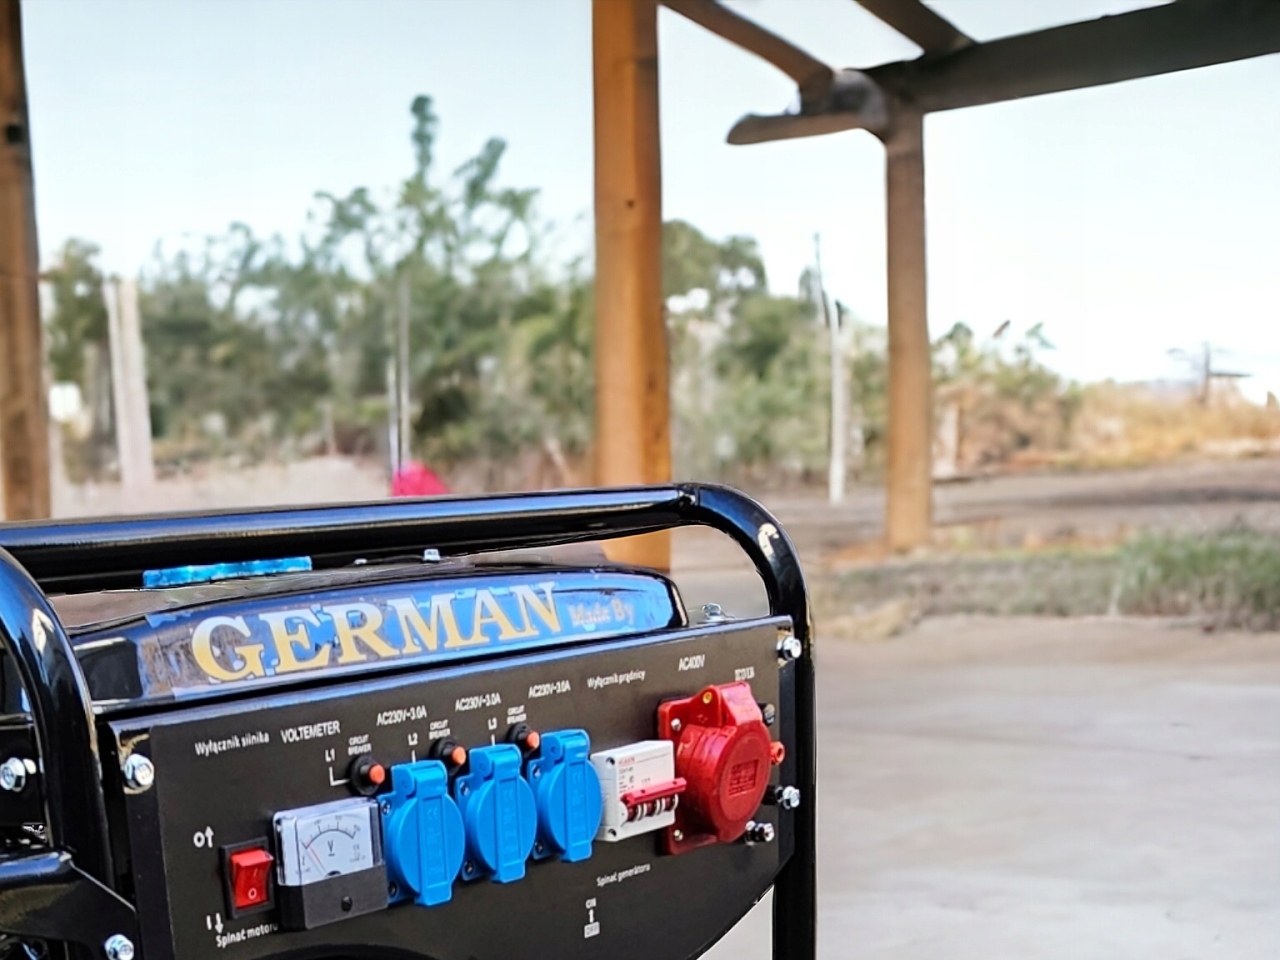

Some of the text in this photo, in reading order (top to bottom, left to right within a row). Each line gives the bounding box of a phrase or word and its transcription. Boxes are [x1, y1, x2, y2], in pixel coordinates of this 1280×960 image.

[190, 580, 565, 682] GERMAN
[280, 720, 341, 744] VOLTEMETER
[407, 733, 418, 746] L2
[324, 749, 336, 763] L1
